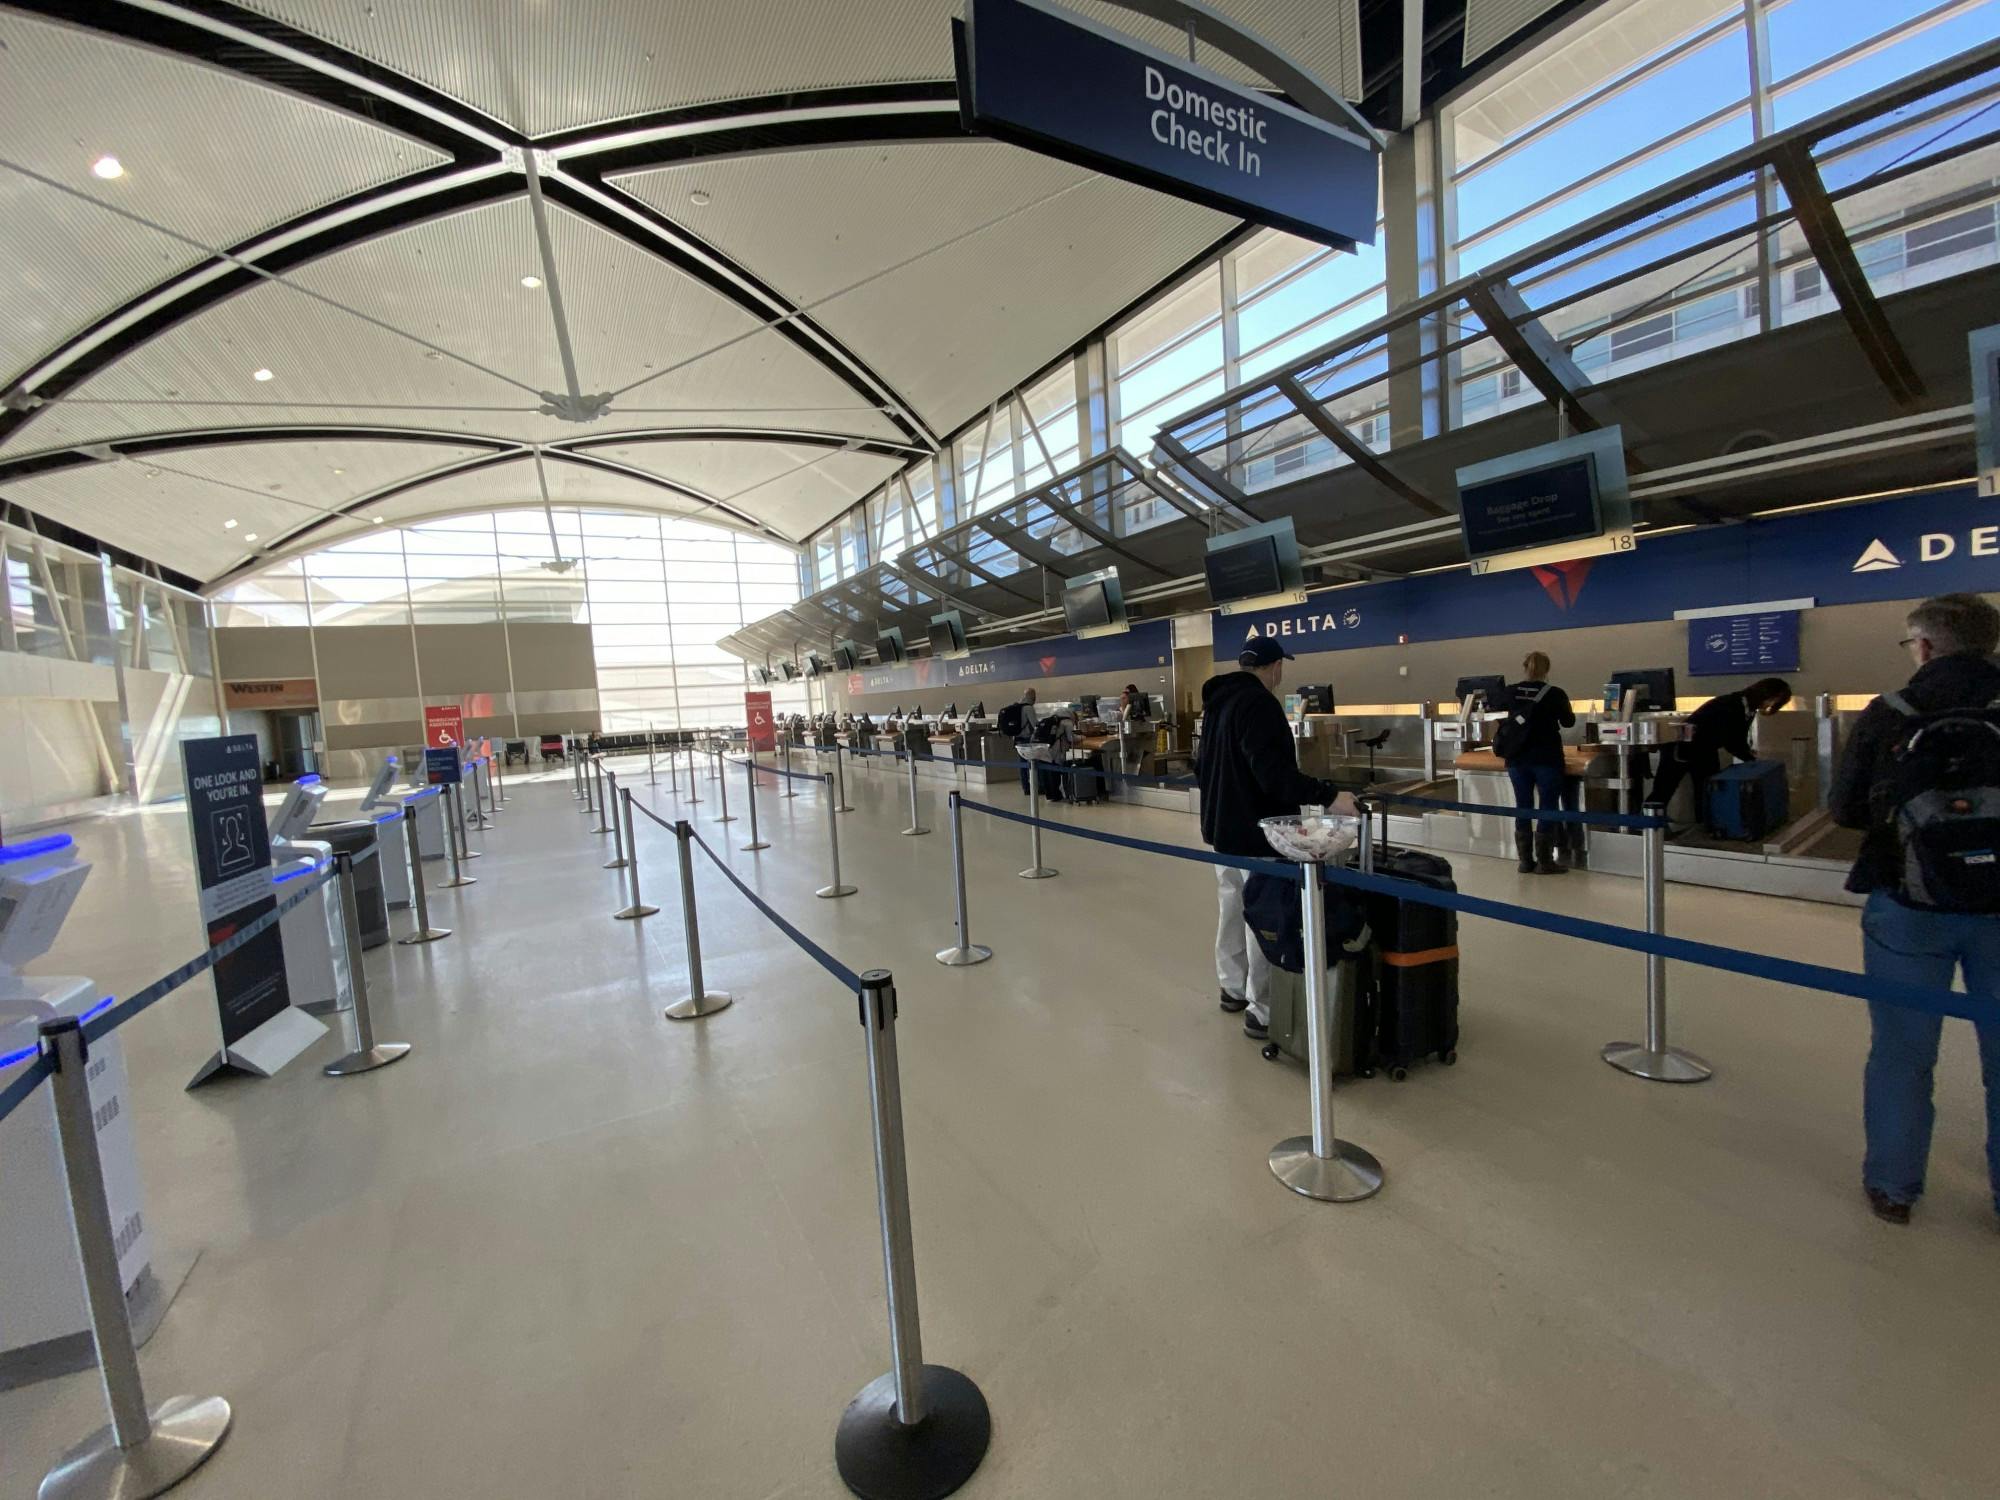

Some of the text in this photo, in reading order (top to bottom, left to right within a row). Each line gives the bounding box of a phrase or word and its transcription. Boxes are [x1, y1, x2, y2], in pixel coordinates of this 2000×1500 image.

[1145, 66, 1267, 144] Domestic
[1151, 109, 1261, 177] Check In
[1531, 494, 1559, 505] Drop
[1609, 535, 1632, 551] 18
[1473, 559, 1490, 573] 17
[1292, 592, 1305, 602] 16
[1221, 605, 1232, 615] 15
[1266, 613, 1336, 637] DELTA
[965, 663, 989, 675] DELTA
[193, 768, 257, 790] ONE LOOK AND
[206, 785, 239, 802] YOU'RE
